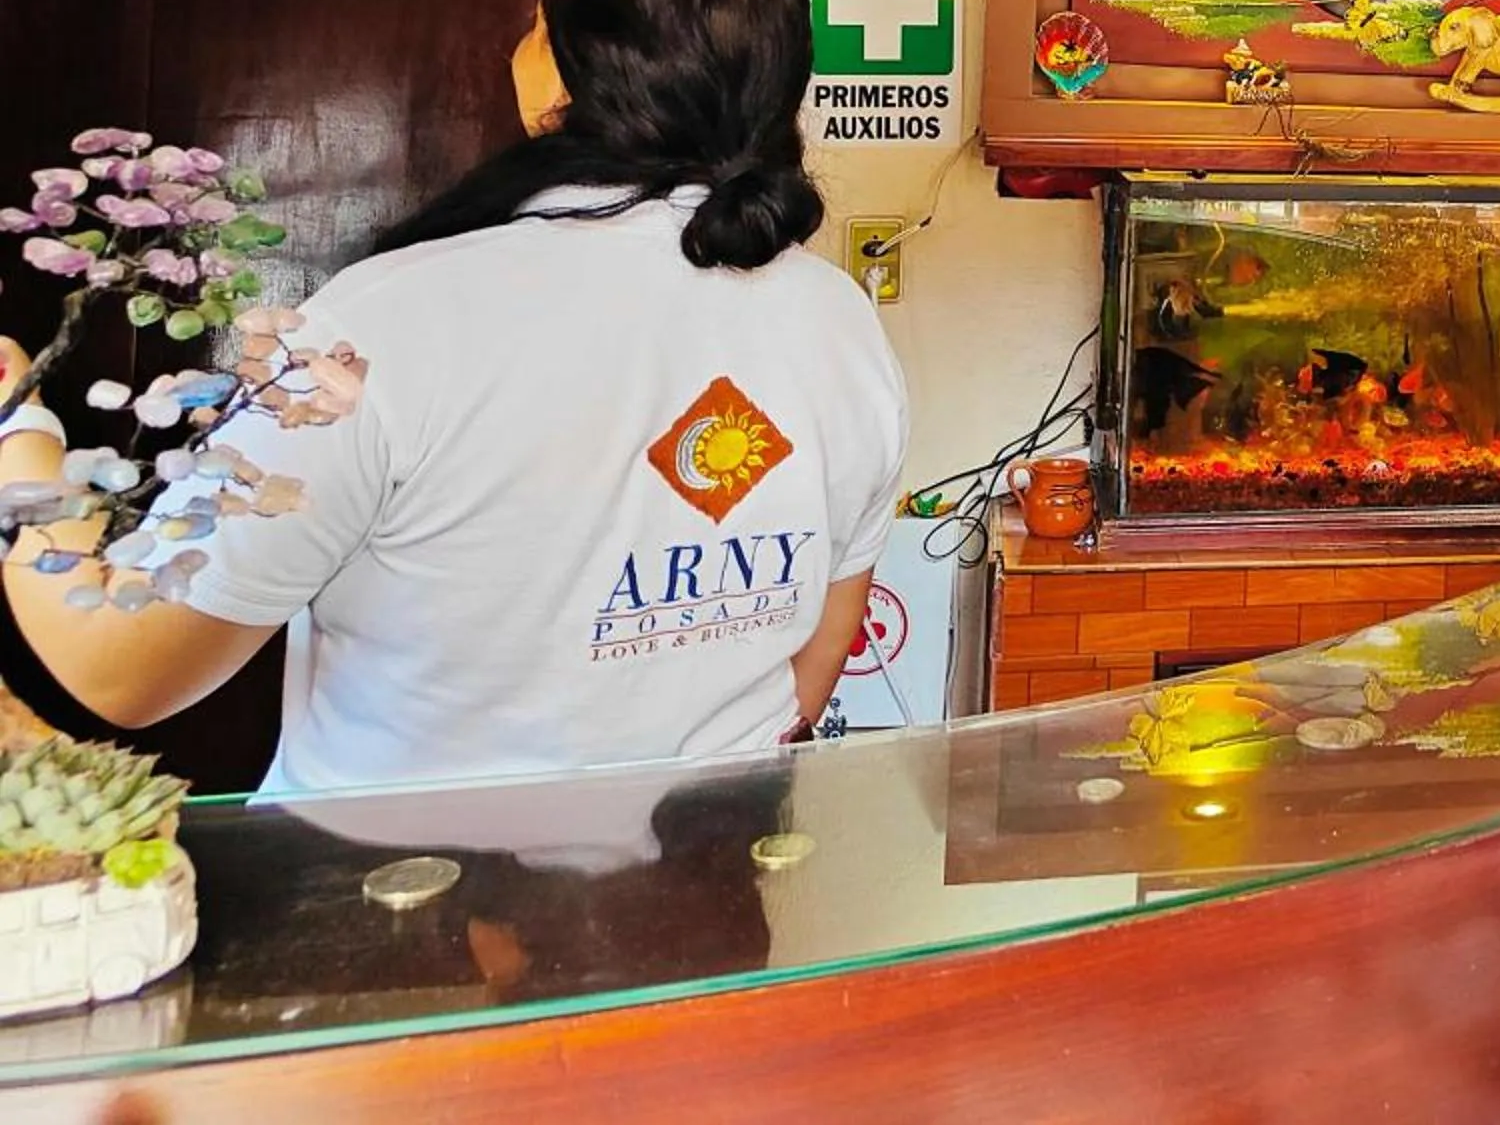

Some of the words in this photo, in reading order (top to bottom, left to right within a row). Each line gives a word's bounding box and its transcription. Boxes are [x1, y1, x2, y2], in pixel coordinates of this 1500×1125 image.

[814, 85, 949, 108] PRIMEROS
[823, 116, 941, 140] AUXILIOS
[597, 532, 816, 613] ARNY
[591, 639, 659, 662] LOVE
[701, 610, 796, 643] BUSINESS
[592, 589, 799, 641] POSADA
